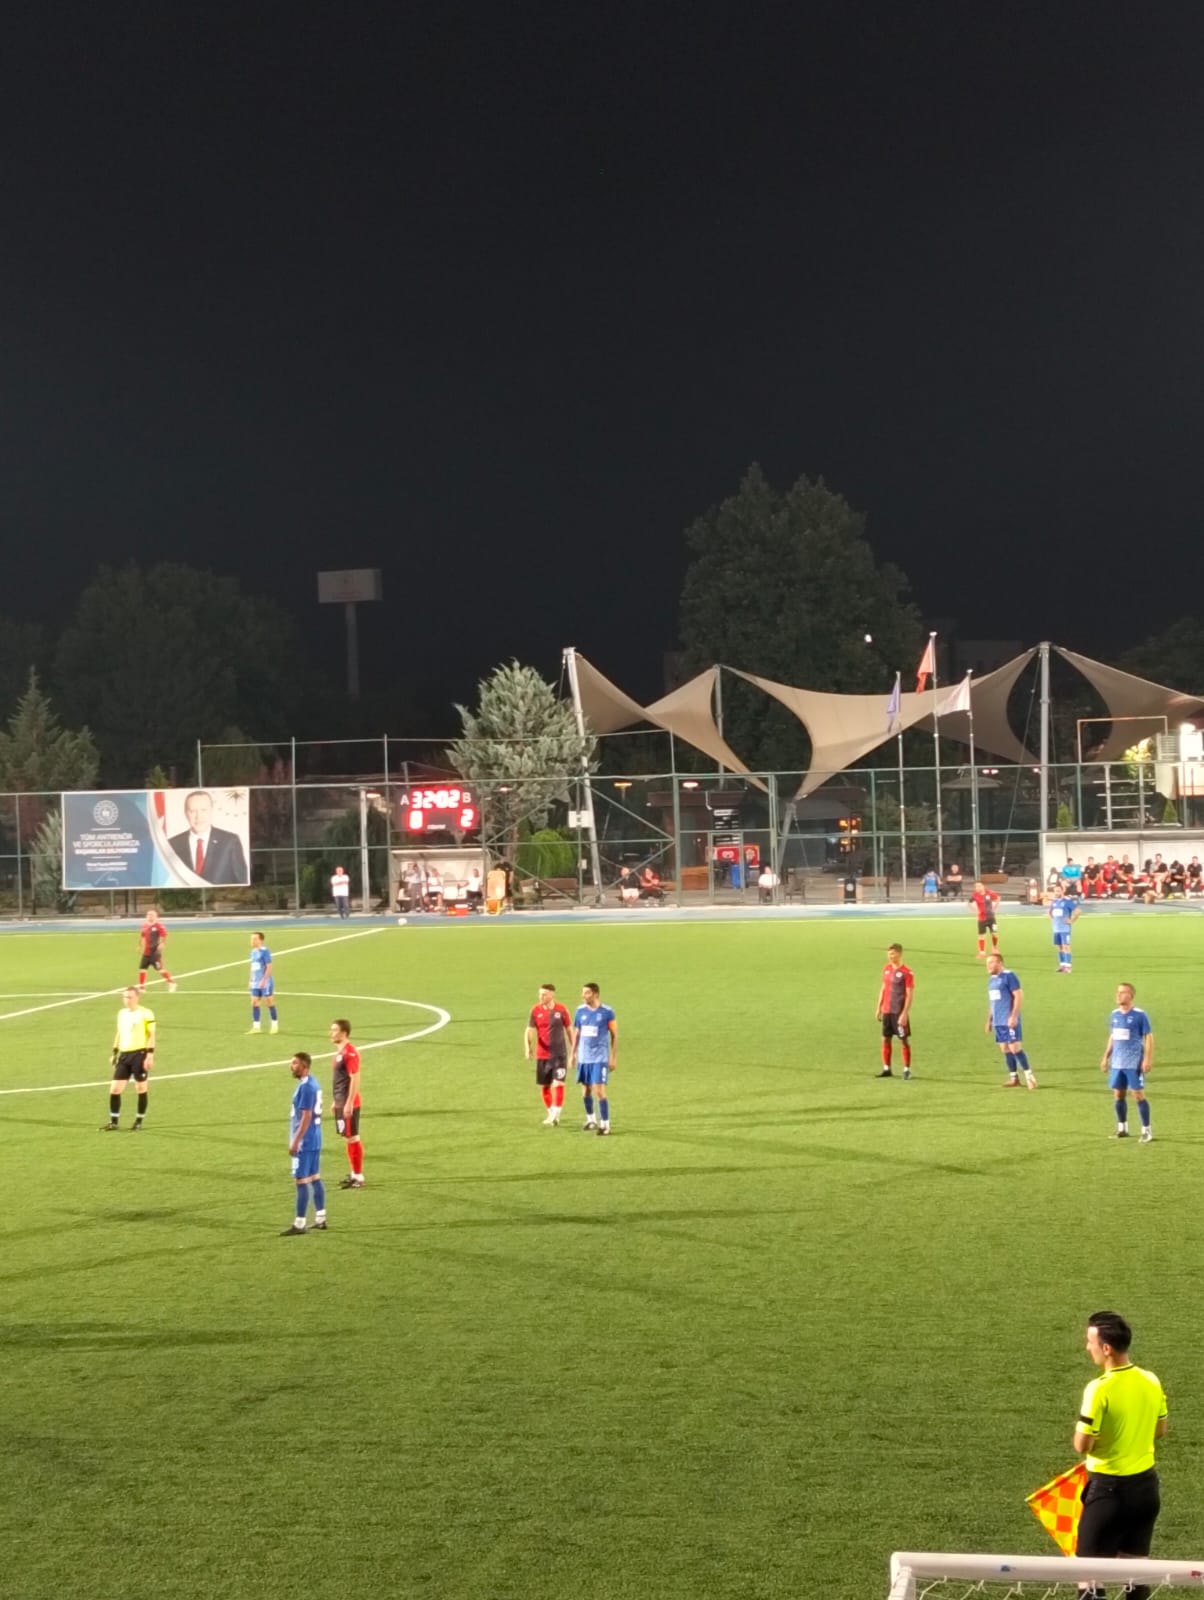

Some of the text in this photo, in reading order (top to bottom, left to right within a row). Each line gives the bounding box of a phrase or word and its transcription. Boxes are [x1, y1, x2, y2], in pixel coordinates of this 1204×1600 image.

[400, 794, 410, 806] A
[462, 792, 472, 804] B
[460, 808, 474, 828] 2
